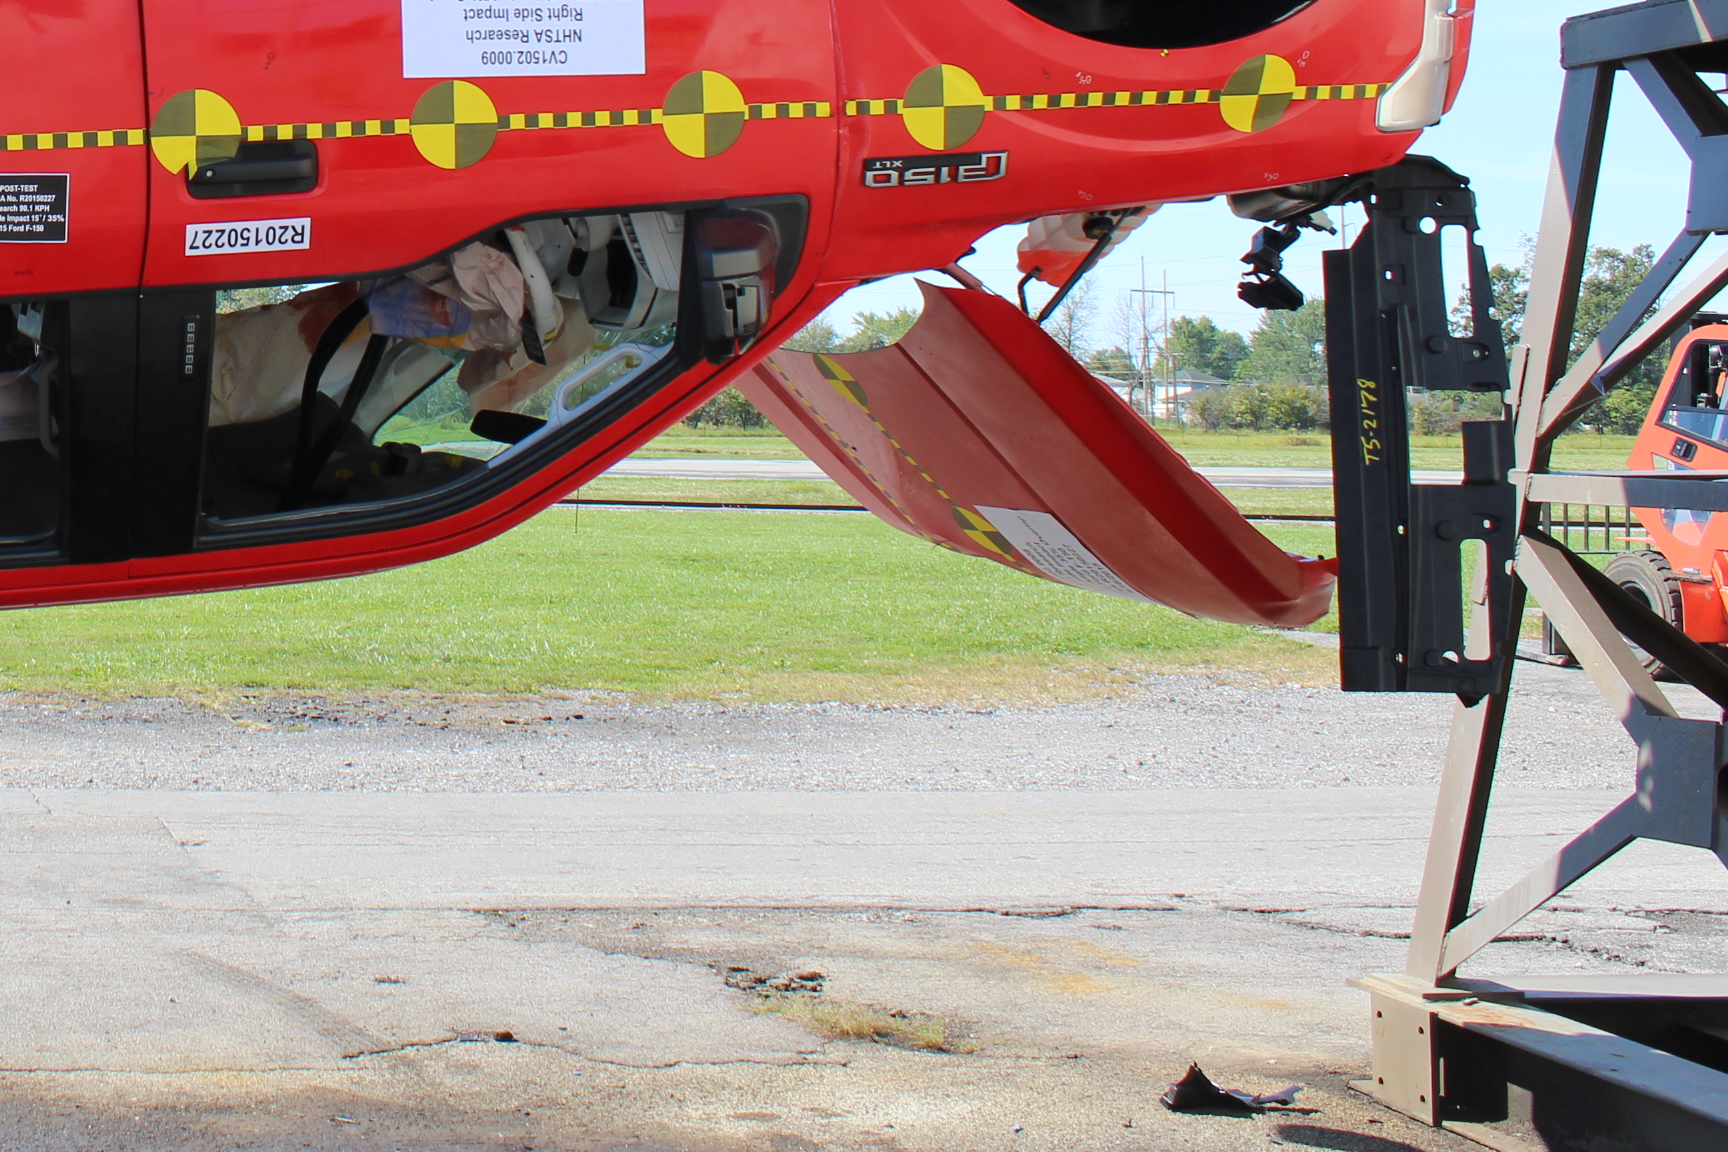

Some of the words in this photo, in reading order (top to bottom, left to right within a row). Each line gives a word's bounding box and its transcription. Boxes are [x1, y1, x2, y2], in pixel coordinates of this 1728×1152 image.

[463, 4, 510, 23] Impact
[513, 7, 544, 23] Side
[547, 3, 584, 22] Right
[465, 29, 530, 44] Research
[533, 28, 583, 44] NHTSA
[481, 49, 568, 66] CV1502.0009
[872, 160, 902, 169] XLT
[0, 184, 38, 193] POST-TEST
[19, 194, 56, 203] R20150227
[19, 204, 33, 212] 90.1
[34, 204, 50, 212] KPH
[6, 214, 30, 224] Impact
[47, 214, 65, 222] 35%
[8, 224, 25, 232] Ford
[25, 224, 45, 232] F-150
[189, 225, 305, 250] R20150227
